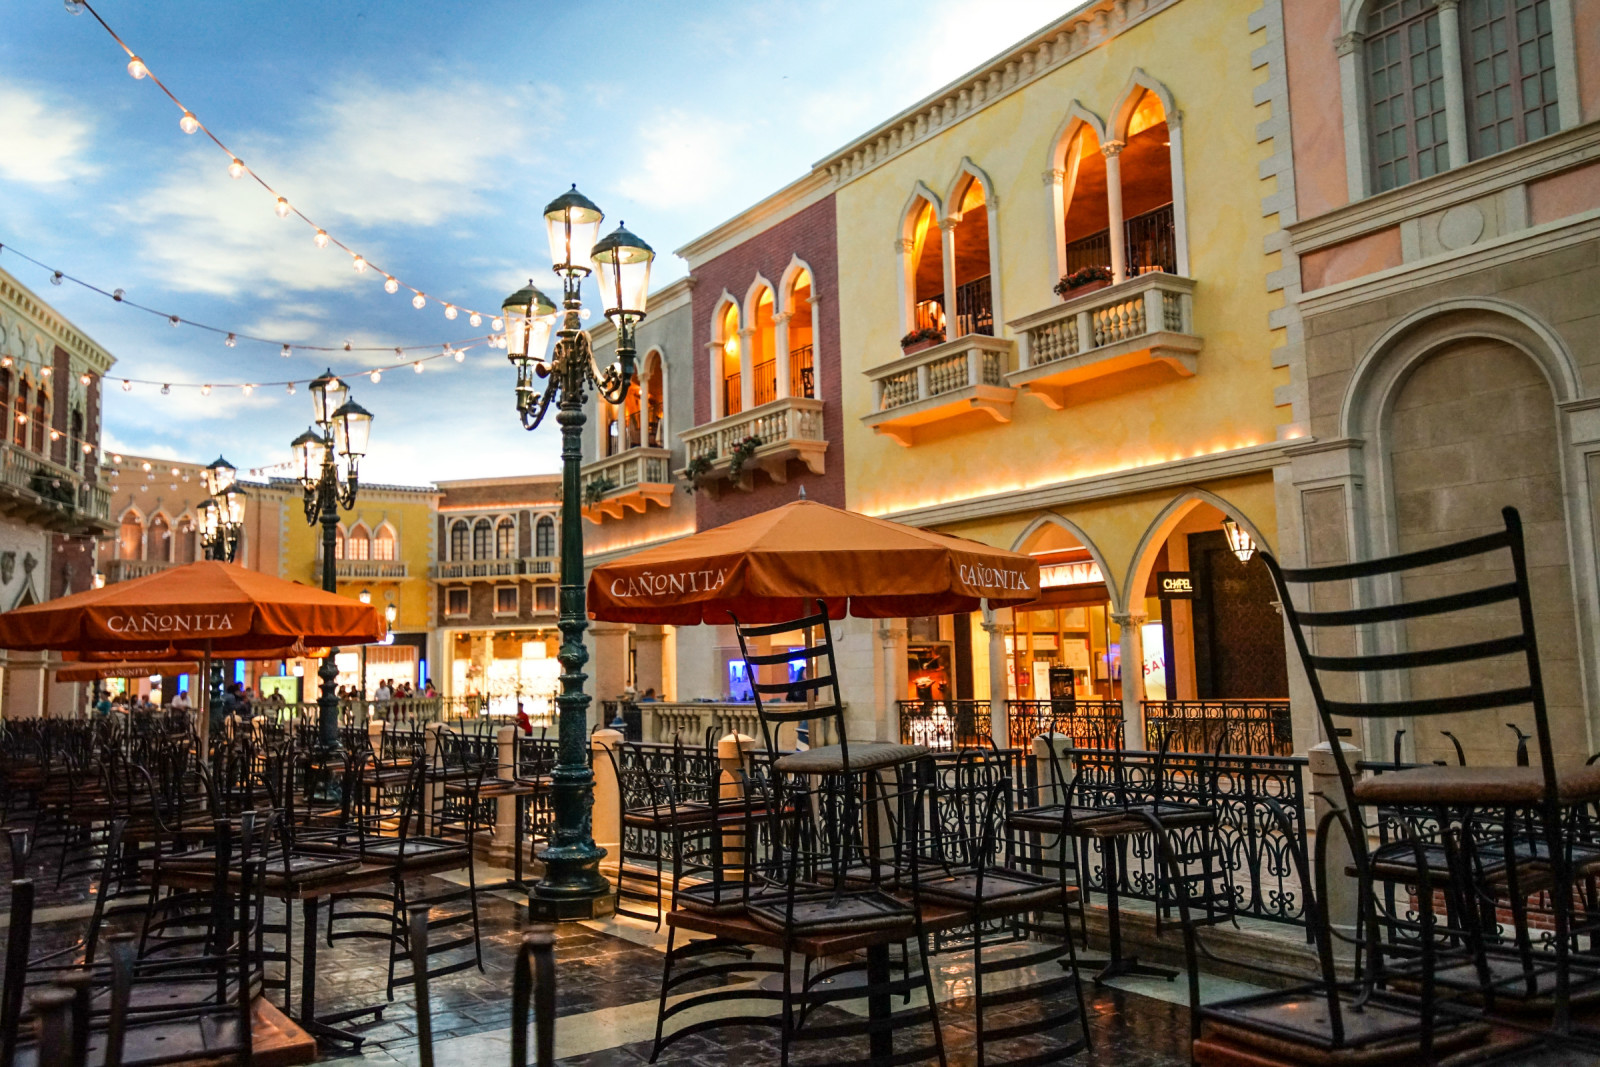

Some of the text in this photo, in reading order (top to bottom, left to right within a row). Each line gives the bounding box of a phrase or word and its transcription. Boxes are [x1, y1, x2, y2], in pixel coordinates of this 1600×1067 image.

[610, 568, 725, 597] CAÑONITA
[960, 563, 1030, 590] CAÑONITA
[1163, 578, 1192, 589] CHAPEL
[107, 612, 233, 632] CAÑONITA
